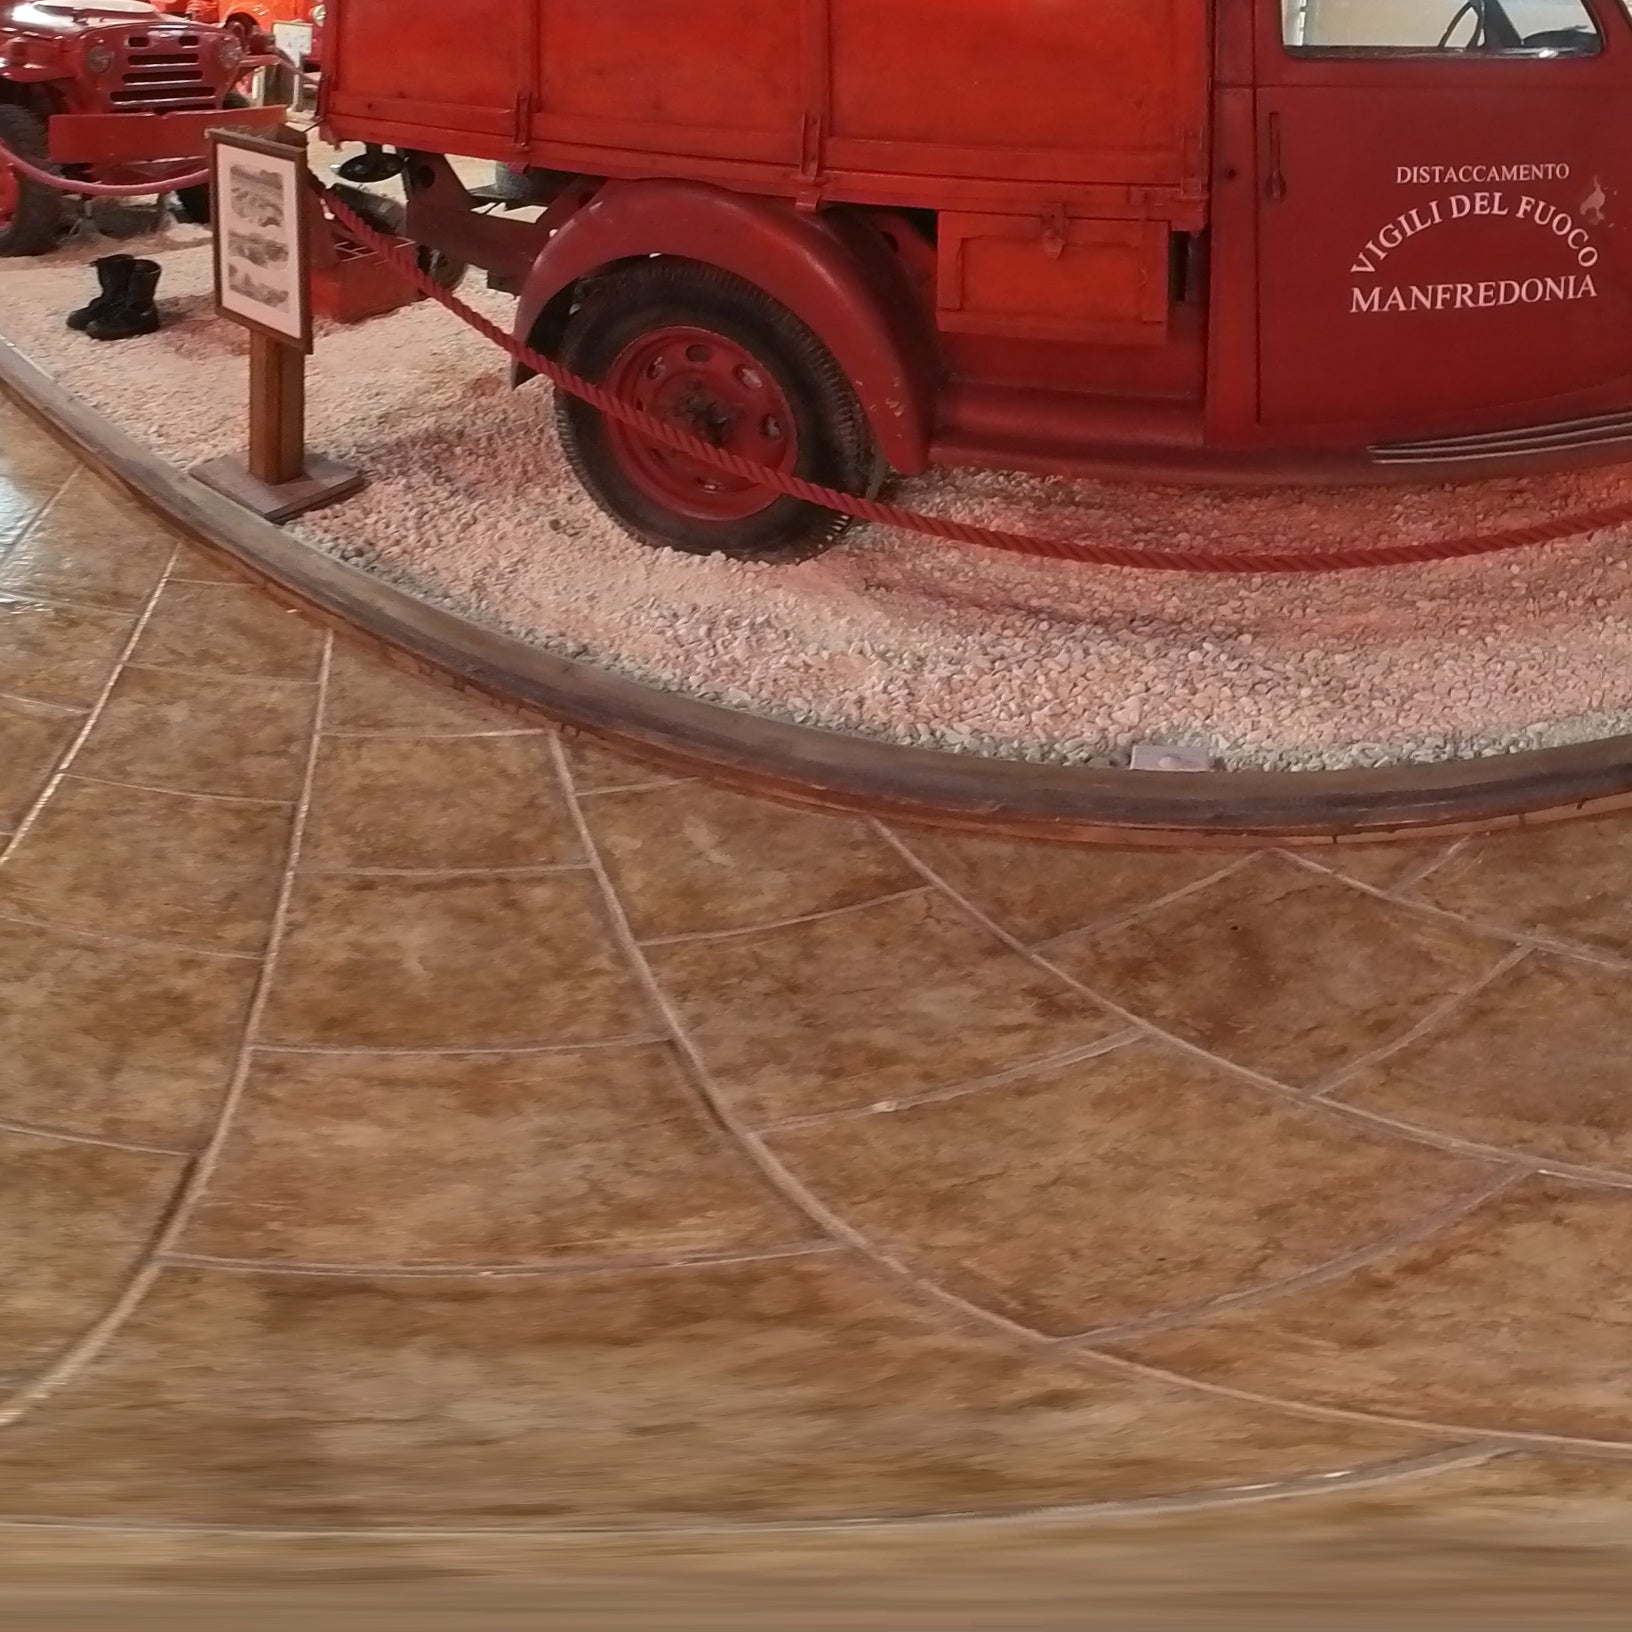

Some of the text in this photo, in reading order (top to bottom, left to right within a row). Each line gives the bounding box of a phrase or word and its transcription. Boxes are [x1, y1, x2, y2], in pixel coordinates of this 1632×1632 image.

[1395, 163, 1570, 184] DISTACCAMENTO
[1350, 192, 1599, 275] VIGILI DEL FUOCO
[1349, 274, 1598, 313] MANFREDONIA
